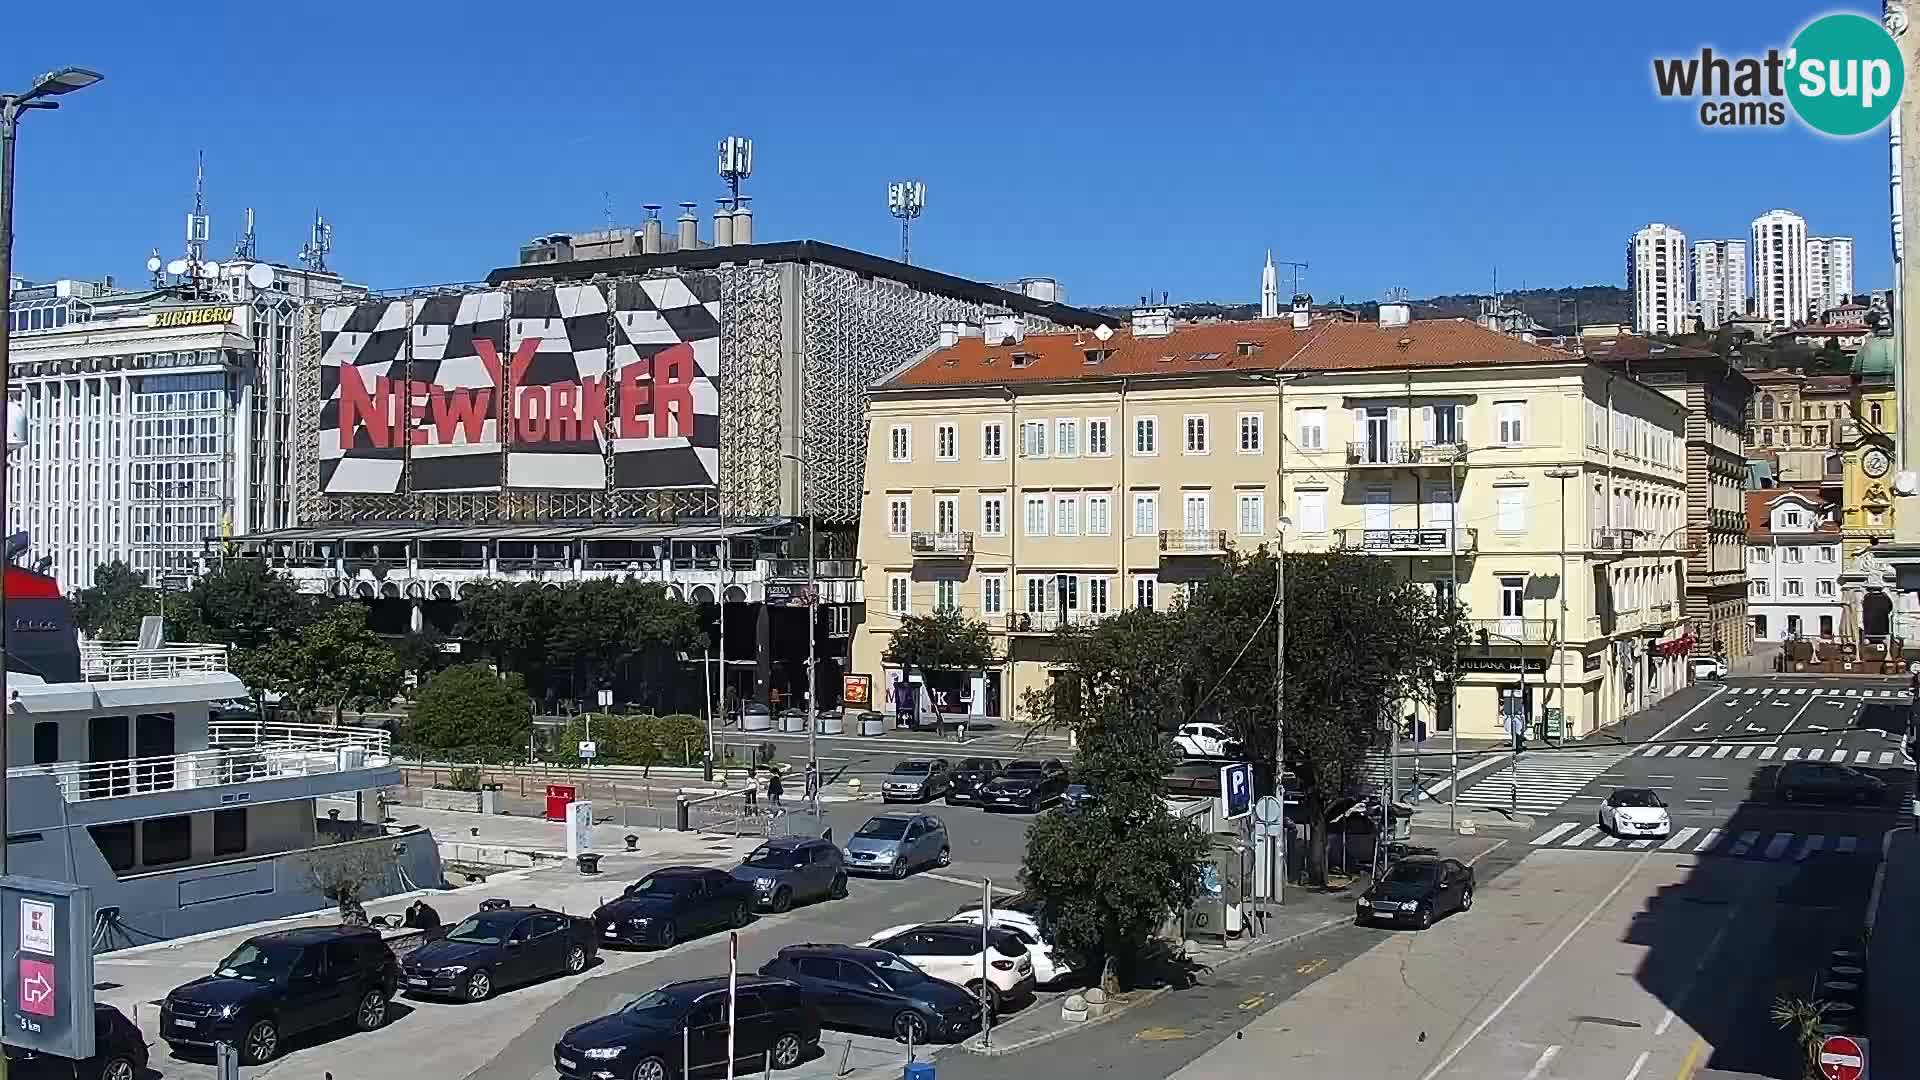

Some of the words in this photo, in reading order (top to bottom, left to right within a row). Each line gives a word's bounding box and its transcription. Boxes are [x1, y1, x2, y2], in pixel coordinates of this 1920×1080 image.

[153, 307, 234, 327] EUROHERO
[1459, 661, 1506, 671] JULIANA
[28, 1019, 41, 1034] km
